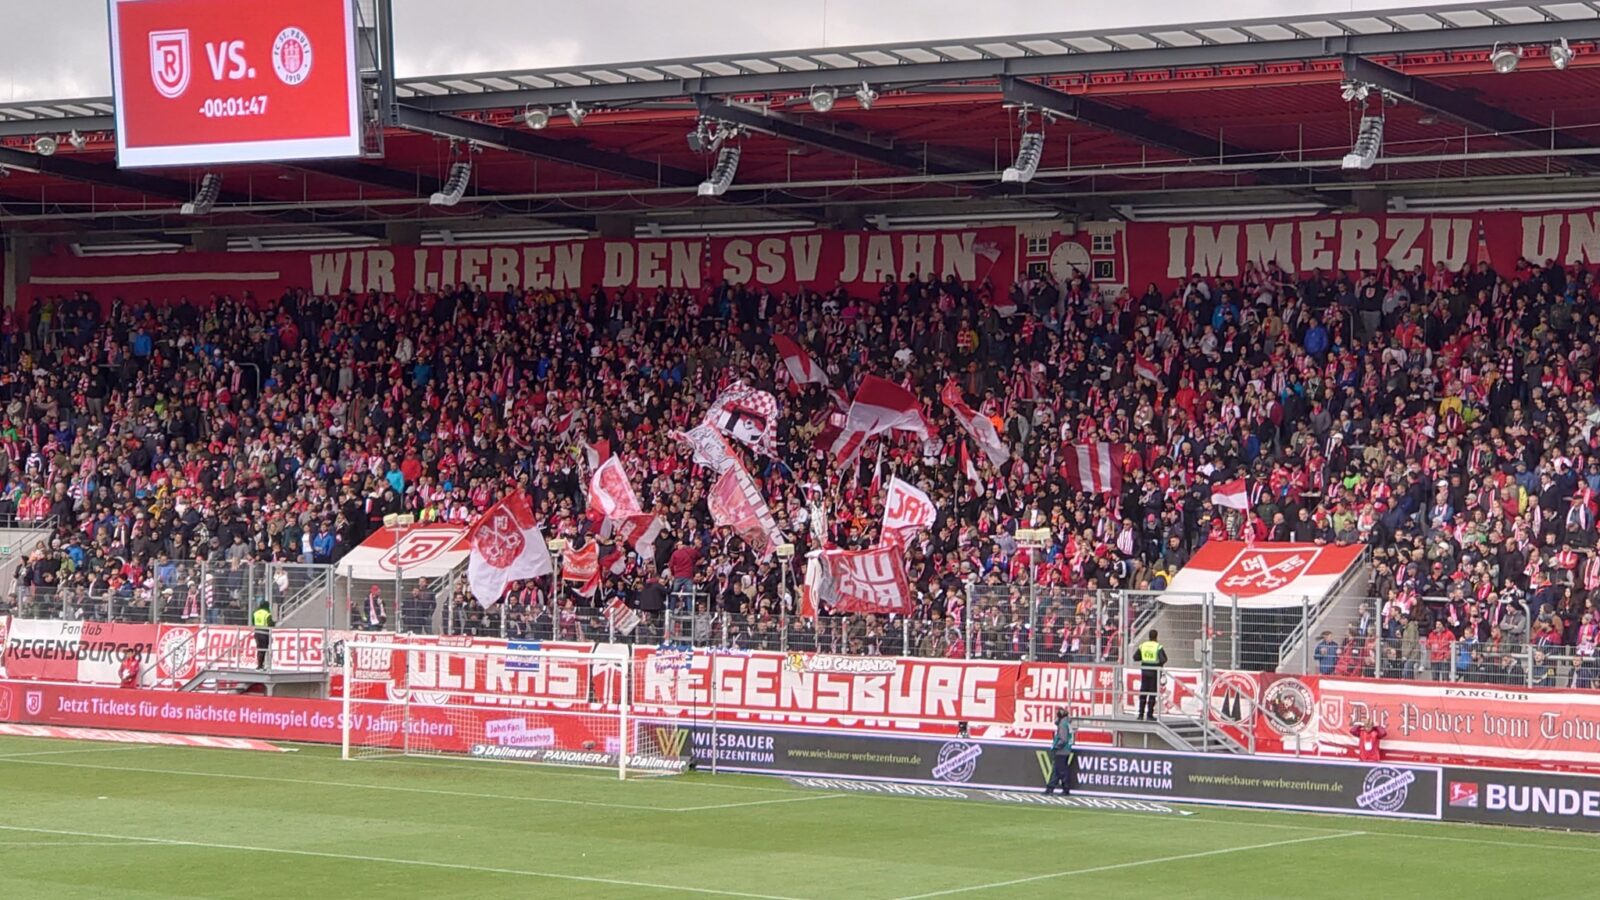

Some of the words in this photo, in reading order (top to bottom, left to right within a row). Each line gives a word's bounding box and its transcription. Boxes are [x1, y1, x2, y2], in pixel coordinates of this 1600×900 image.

[205, 40, 256, 81] VS.
[199, 95, 267, 118] -00:01:47
[310, 250, 395, 296] WIR
[414, 244, 585, 293] LIEBEN
[603, 241, 701, 288] DEN
[723, 234, 823, 285] SSV
[839, 232, 978, 283] JAHN
[1167, 218, 1473, 278] IMMERZU
[61, 623, 102, 636] Fanclub
[8, 638, 128, 664] REGENSBURG
[355, 647, 392, 669] 1889
[408, 642, 577, 697] ULTRAS
[644, 653, 1000, 720] REGENSBURG
[1024, 667, 1093, 700] JAHN
[1445, 688, 1529, 701] FANCLUB
[58, 696, 89, 713] Jetzt
[91, 697, 136, 716] Tickets
[139, 701, 158, 717] für
[161, 703, 183, 718] das
[186, 705, 236, 722] nächste
[239, 706, 308, 730] Heimspiel
[310, 712, 334, 728] des
[366, 715, 397, 732] Jahn
[1023, 704, 1092, 723] STAON
[1350, 701, 1389, 729] Die
[1401, 702, 1475, 737] Power
[1482, 710, 1530, 740] vom
[691, 732, 774, 749] WIESBAUER
[485, 745, 537, 758] Dallmeier
[691, 748, 775, 763] WERBEZENTRUM
[787, 748, 921, 765] www.wiesbauer-werbezentrum.de
[631, 756, 686, 769] Dallmeier
[1077, 755, 1173, 775] WIESBAUER
[1076, 773, 1173, 790] WERBEZENTRUM
[1188, 773, 1344, 793] www.wiesbauer-werbezentrum.de
